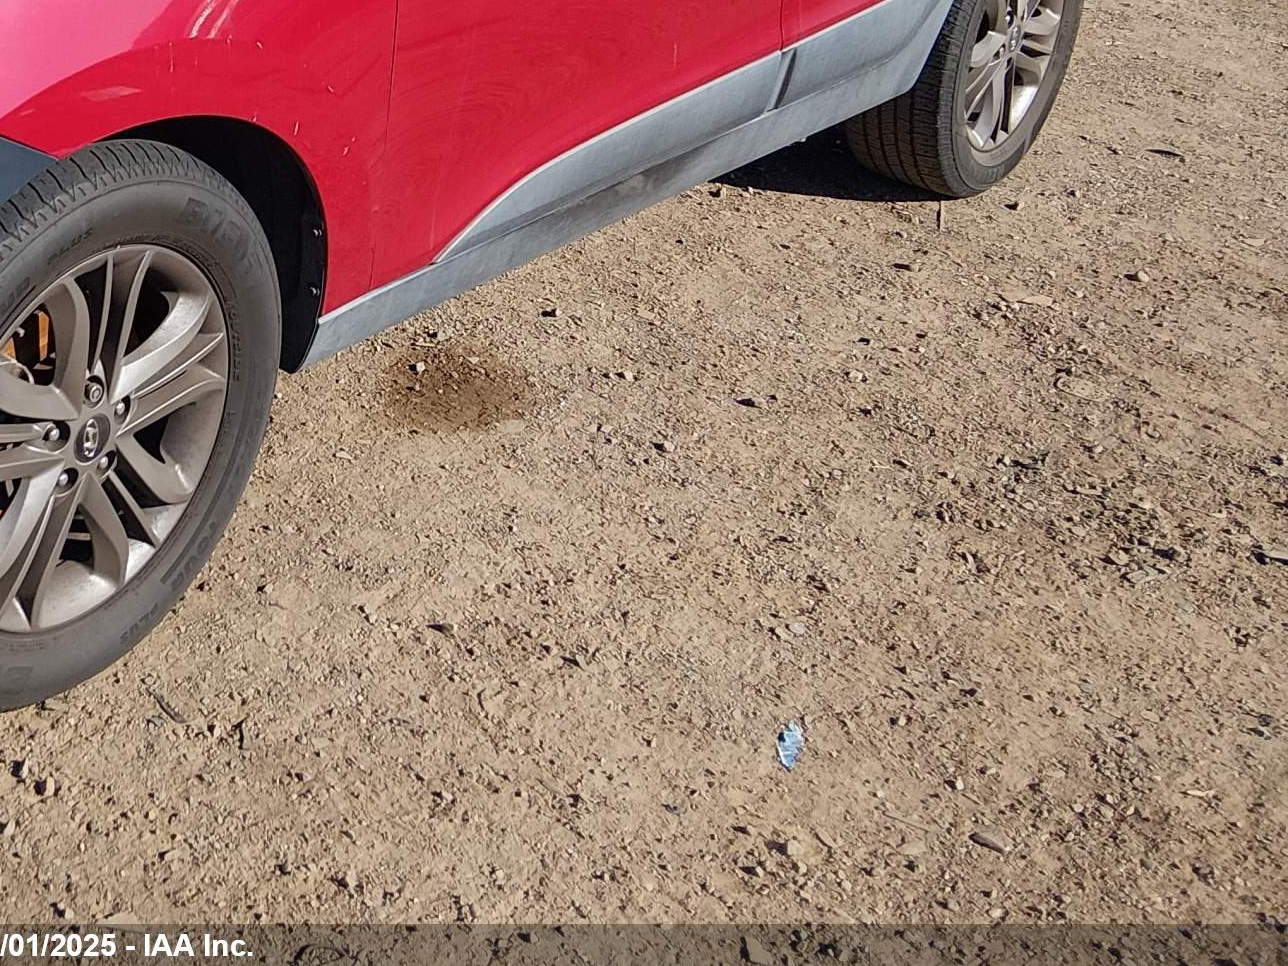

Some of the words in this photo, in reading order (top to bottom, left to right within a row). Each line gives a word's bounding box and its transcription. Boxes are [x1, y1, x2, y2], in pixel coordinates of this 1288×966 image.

[47, 226, 93, 266] PLUS
[168, 520, 220, 592] TOUR
[118, 602, 160, 645] PLUS
